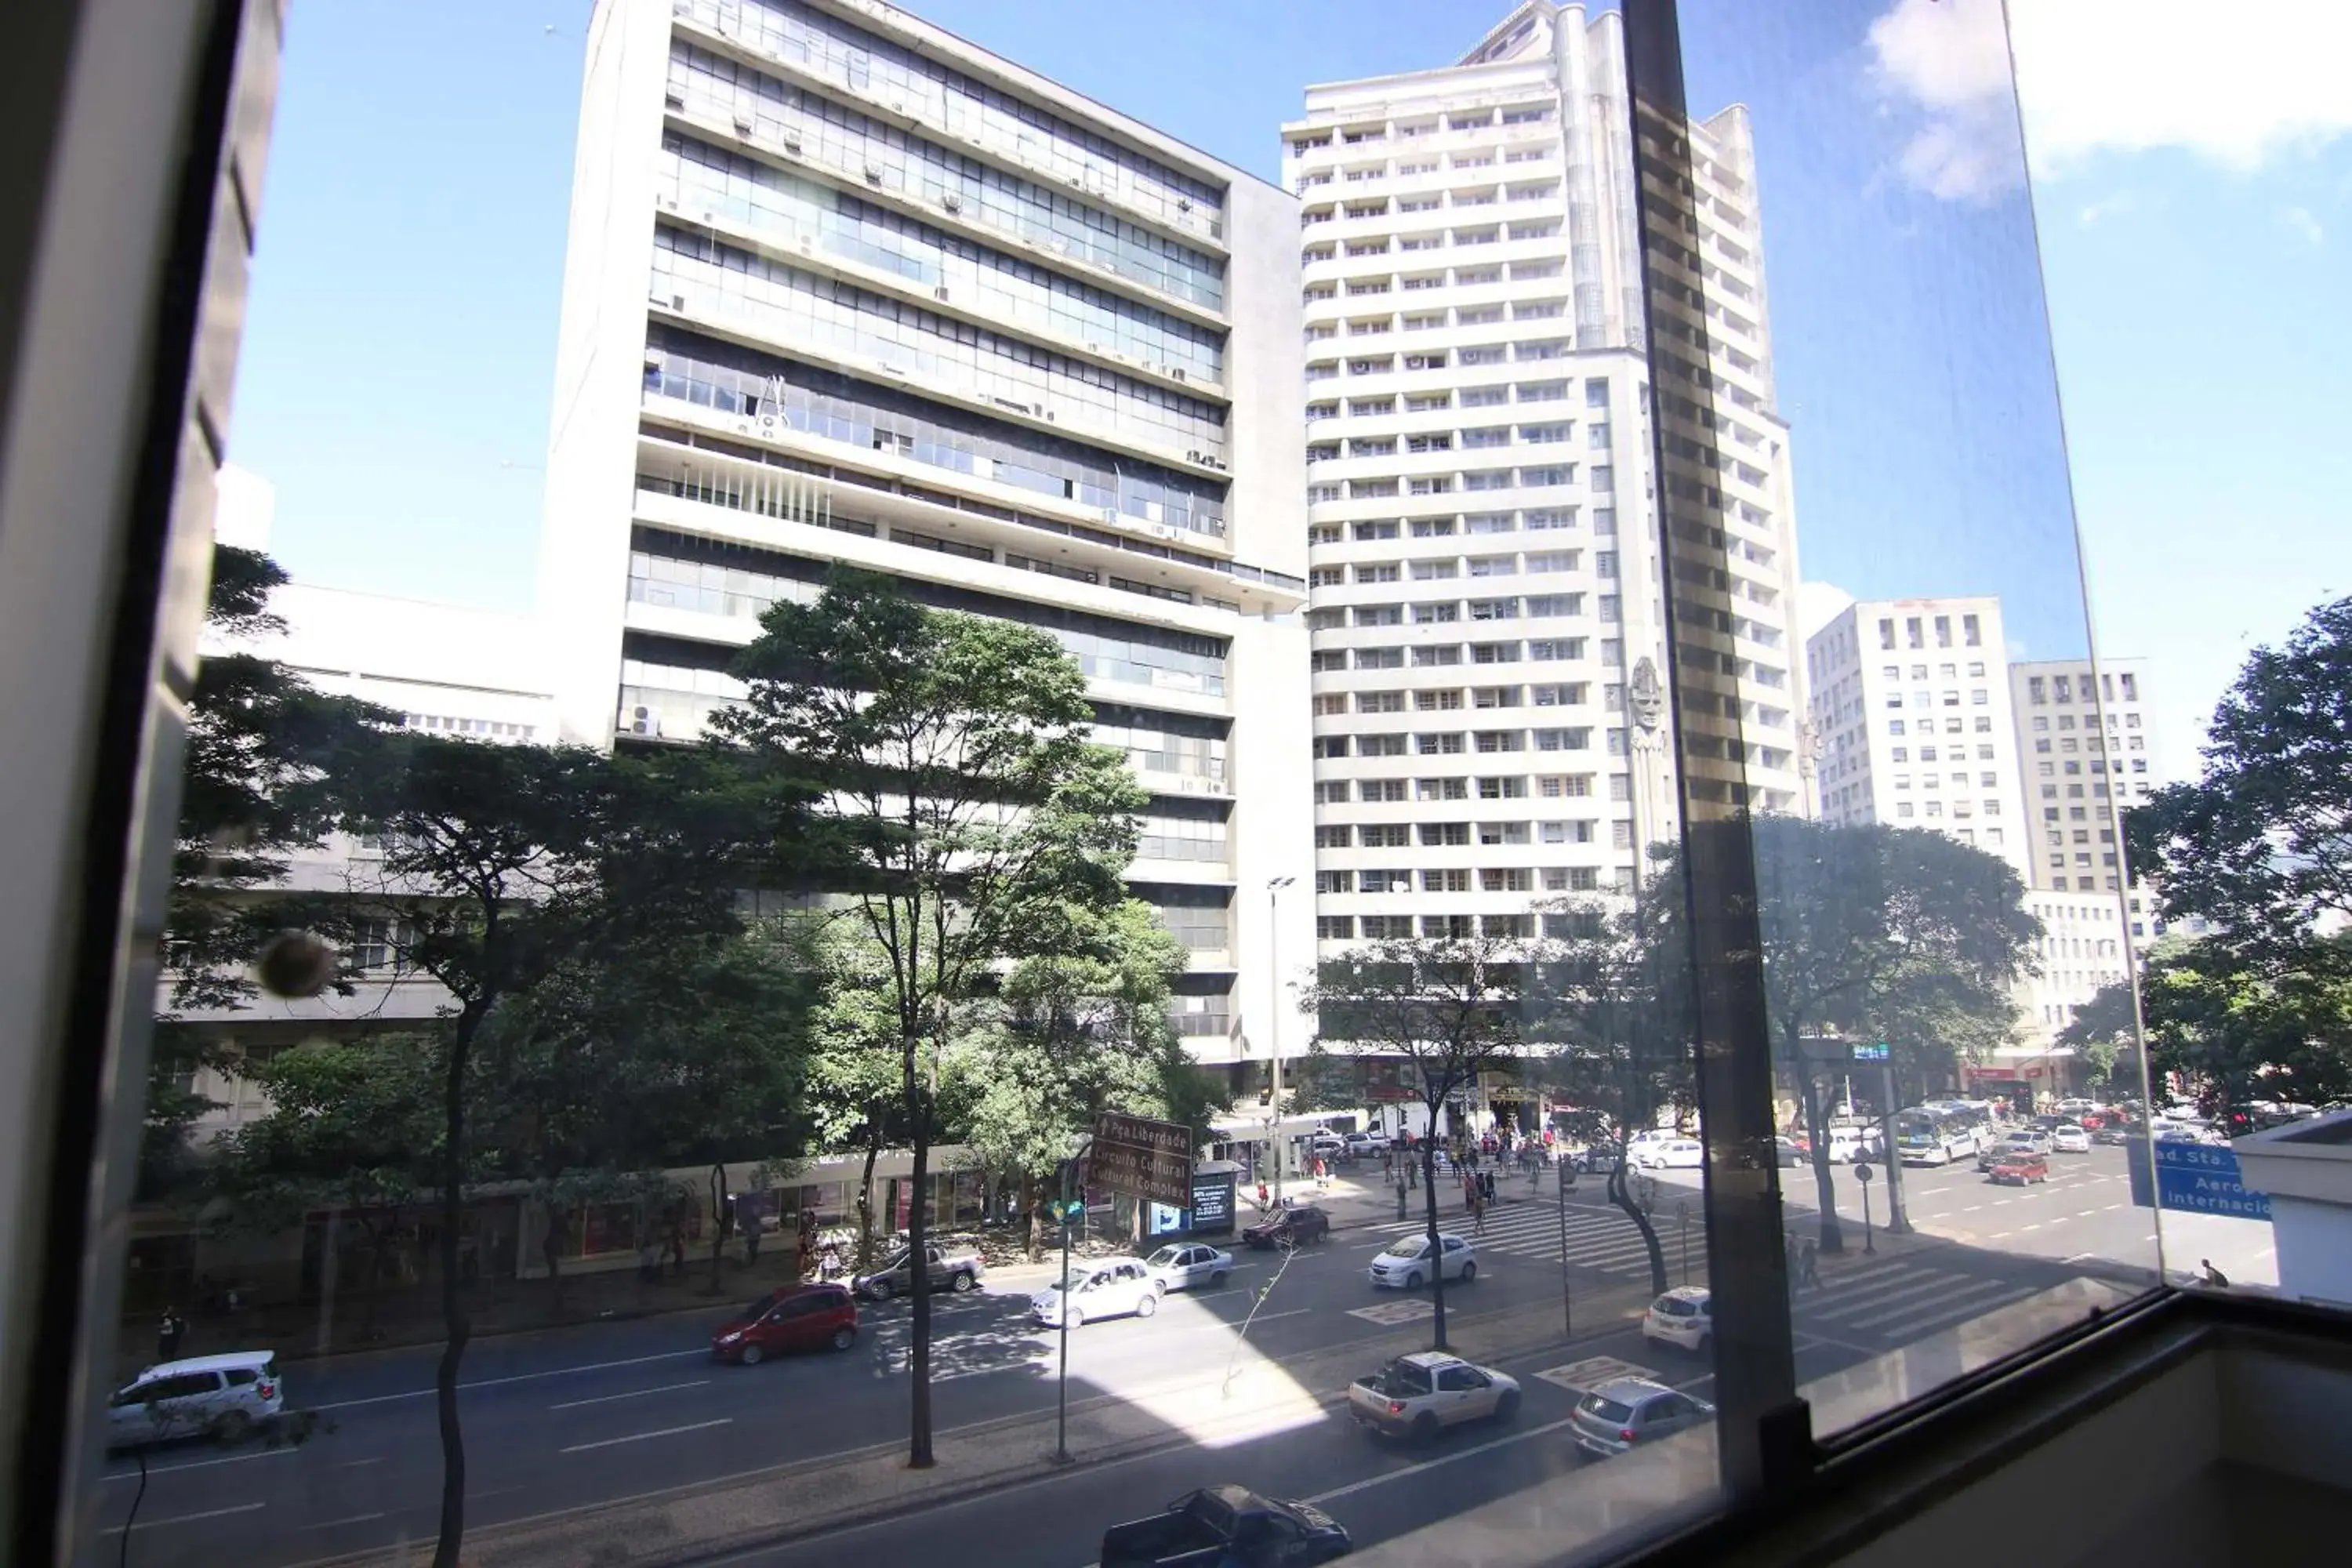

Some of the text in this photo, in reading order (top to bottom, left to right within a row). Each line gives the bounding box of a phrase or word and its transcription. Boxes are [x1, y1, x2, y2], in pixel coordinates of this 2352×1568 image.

[1112, 1122, 1186, 1149] Pça Liberdade
[1095, 1149, 1185, 1178] Circuito Cultural
[1092, 1165, 1185, 1199] Cultural Complex
